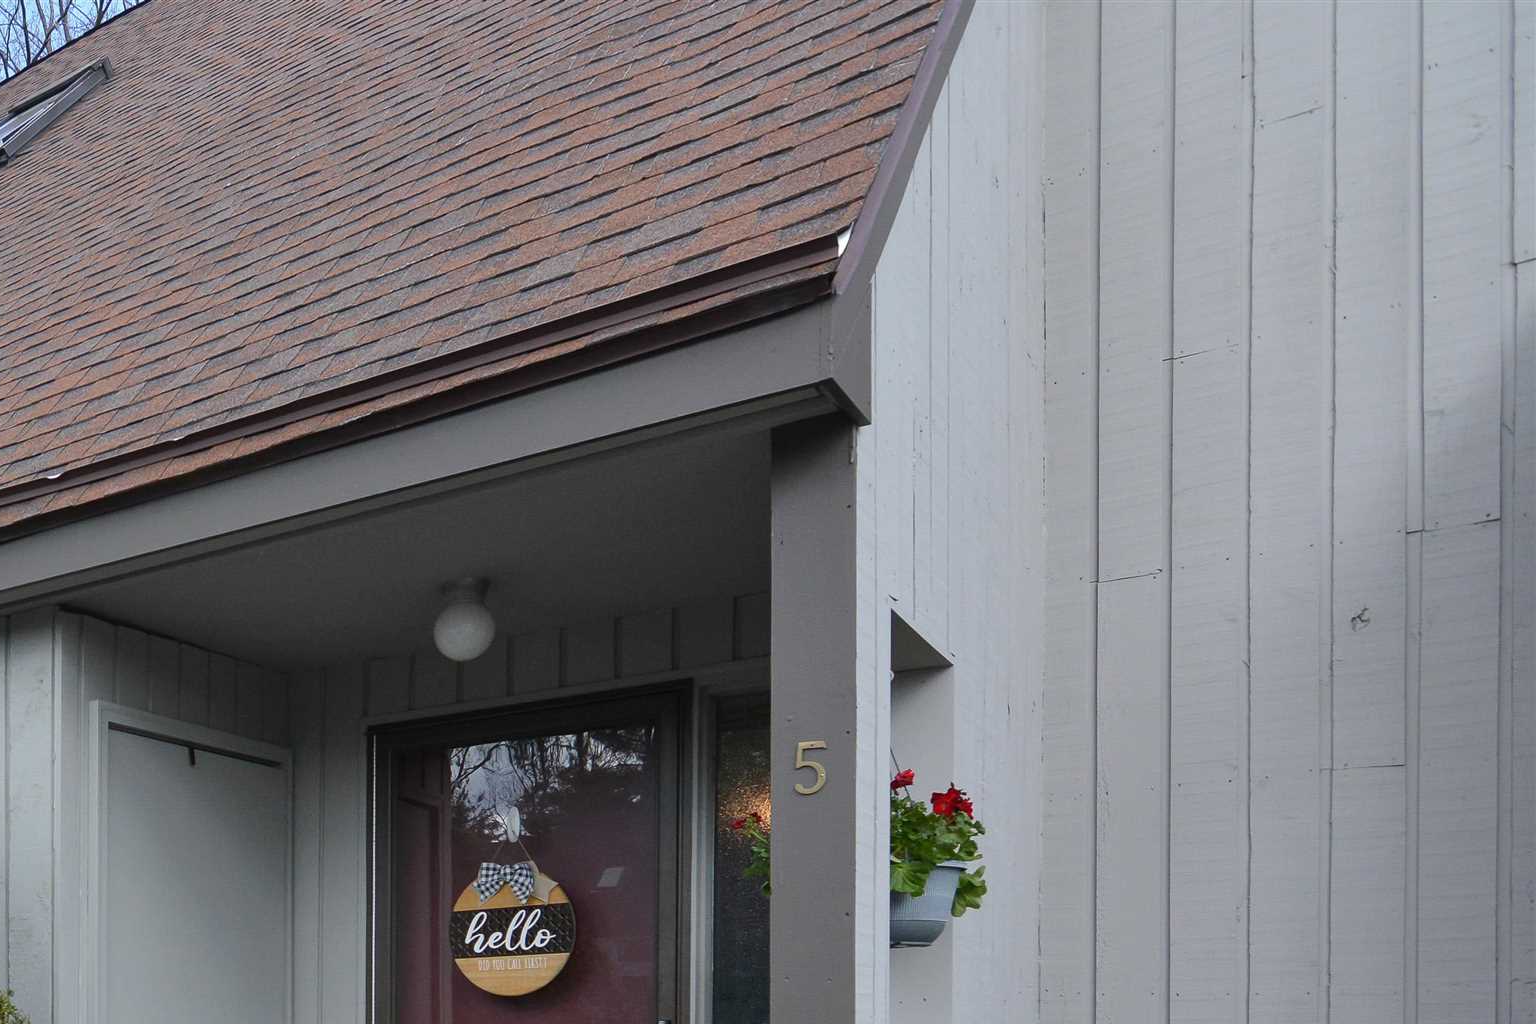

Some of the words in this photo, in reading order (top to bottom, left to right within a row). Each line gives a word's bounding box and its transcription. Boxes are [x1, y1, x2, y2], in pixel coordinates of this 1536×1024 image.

[795, 740, 827, 795] 5
[465, 908, 556, 953] hello
[479, 959, 489, 971] DID
[493, 959, 505, 970] YOU
[508, 958, 521, 970] CALL
